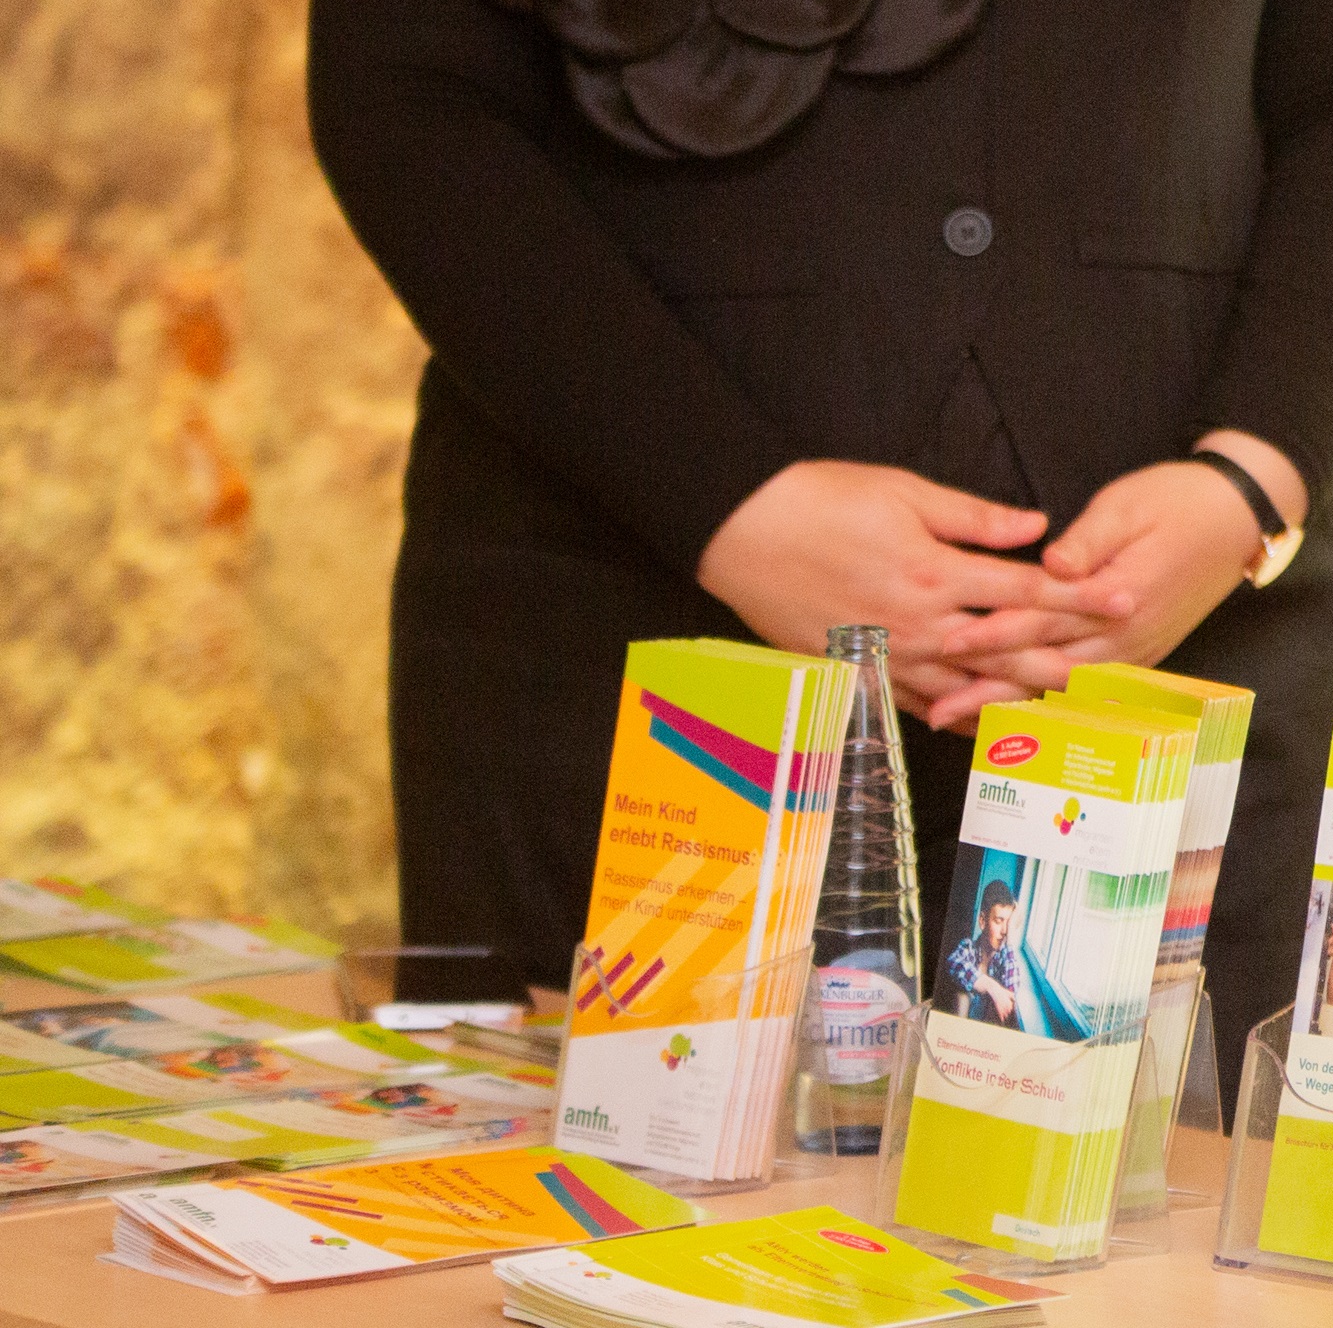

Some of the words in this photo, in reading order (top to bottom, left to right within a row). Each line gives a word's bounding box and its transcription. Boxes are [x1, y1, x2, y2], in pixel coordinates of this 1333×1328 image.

[614, 793, 653, 818] Mein
[658, 801, 697, 826] Kind
[979, 780, 1017, 807] amfn
[609, 826, 657, 849] erlebt
[661, 832, 757, 867] Rassismus:
[603, 867, 674, 895] Rassismus
[676, 883, 736, 907] erkennen
[600, 895, 632, 912] mein
[634, 899, 664, 919] Kind
[667, 907, 744, 933] unterstützen
[931, 1056, 983, 1082] Konflikte
[1020, 1077, 1066, 1102] Schule
[1299, 1058, 1319, 1072] Von
[564, 1105, 610, 1133] amfn
